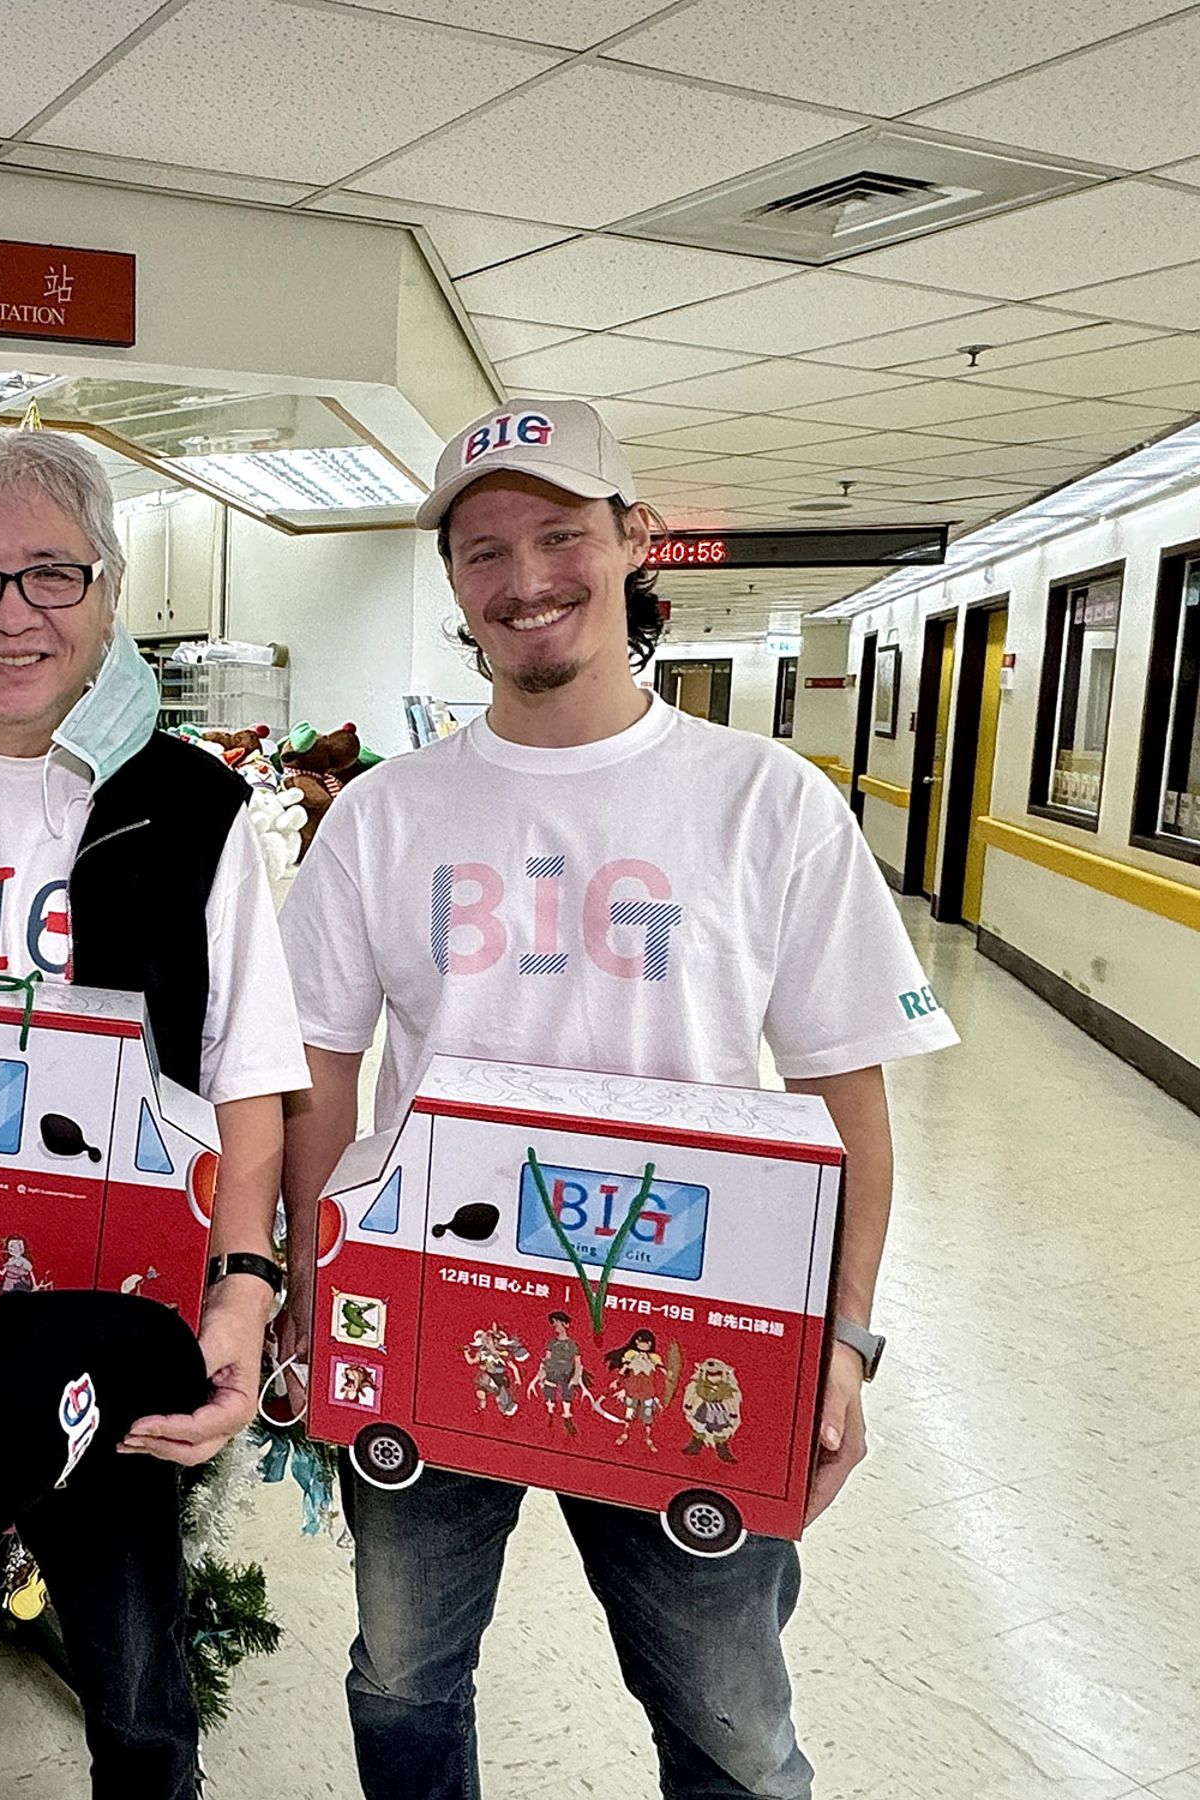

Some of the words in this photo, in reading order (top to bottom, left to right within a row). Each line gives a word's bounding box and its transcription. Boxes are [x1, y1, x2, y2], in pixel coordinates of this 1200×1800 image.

[465, 415, 552, 465] BIG
[430, 855, 683, 981] BIG
[552, 1178, 673, 1245] BIG
[626, 1249, 653, 1264] Gift
[438, 1267, 491, 1289] 12月1日
[494, 1276, 550, 1298] 暖心上映
[603, 1294, 695, 1322] 月17日-19日
